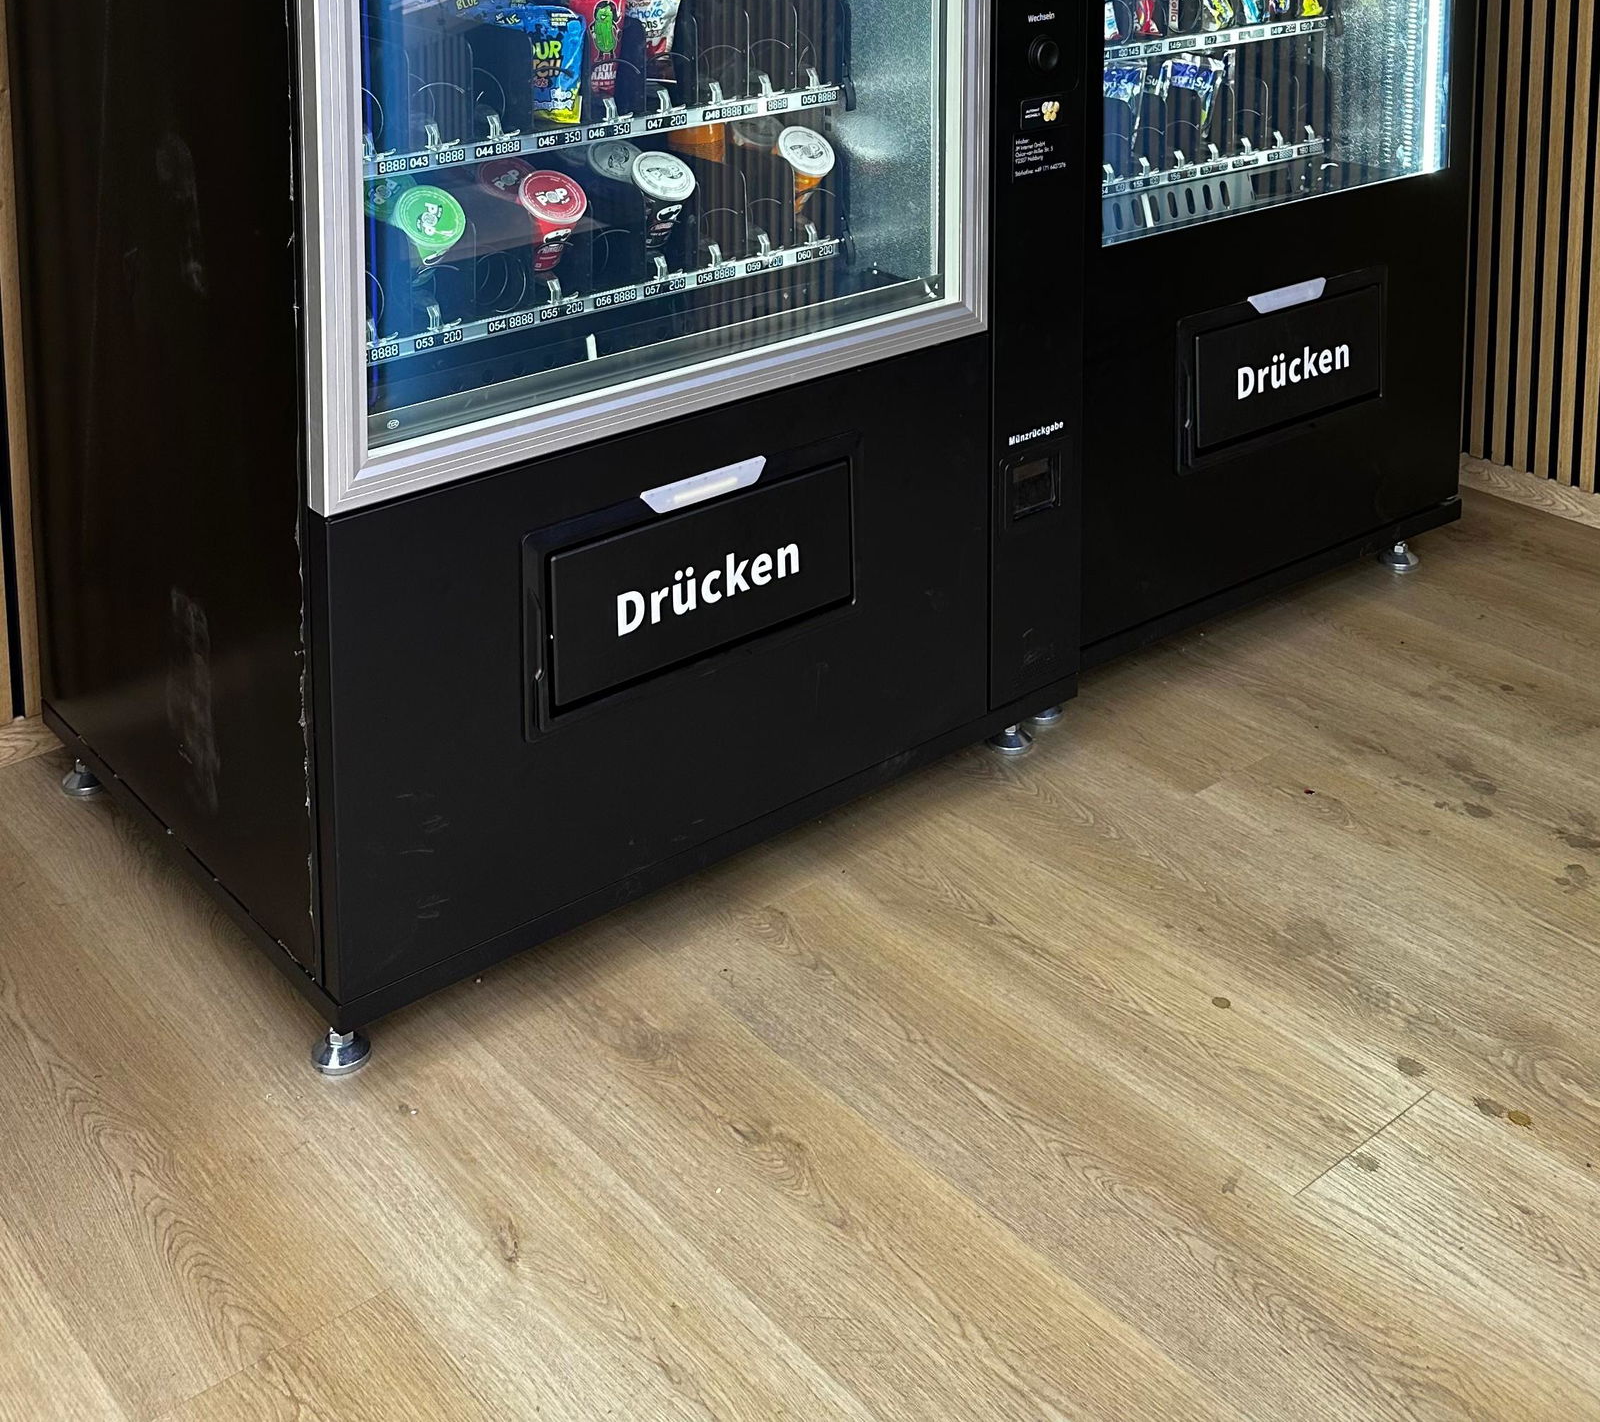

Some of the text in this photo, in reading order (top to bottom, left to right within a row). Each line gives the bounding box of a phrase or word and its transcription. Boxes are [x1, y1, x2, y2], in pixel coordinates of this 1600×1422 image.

[802, 94, 816, 104] 050
[588, 124, 630, 138] 046 350
[647, 119, 662, 129] 047
[539, 131, 581, 146] 045 350
[476, 146, 494, 158] 044
[410, 156, 428, 168] 043
[797, 246, 833, 261] 060 200
[747, 262, 761, 272] 059
[698, 274, 713, 284] 058
[645, 279, 685, 295] 057 200
[596, 295, 612, 307] 056
[542, 302, 583, 320] 055 200
[489, 320, 506, 332] 054
[416, 331, 462, 349] 053 200
[1238, 344, 1350, 400] Drücken
[1009, 421, 1064, 446] Münzrückgabe
[617, 543, 799, 637] Drücken
